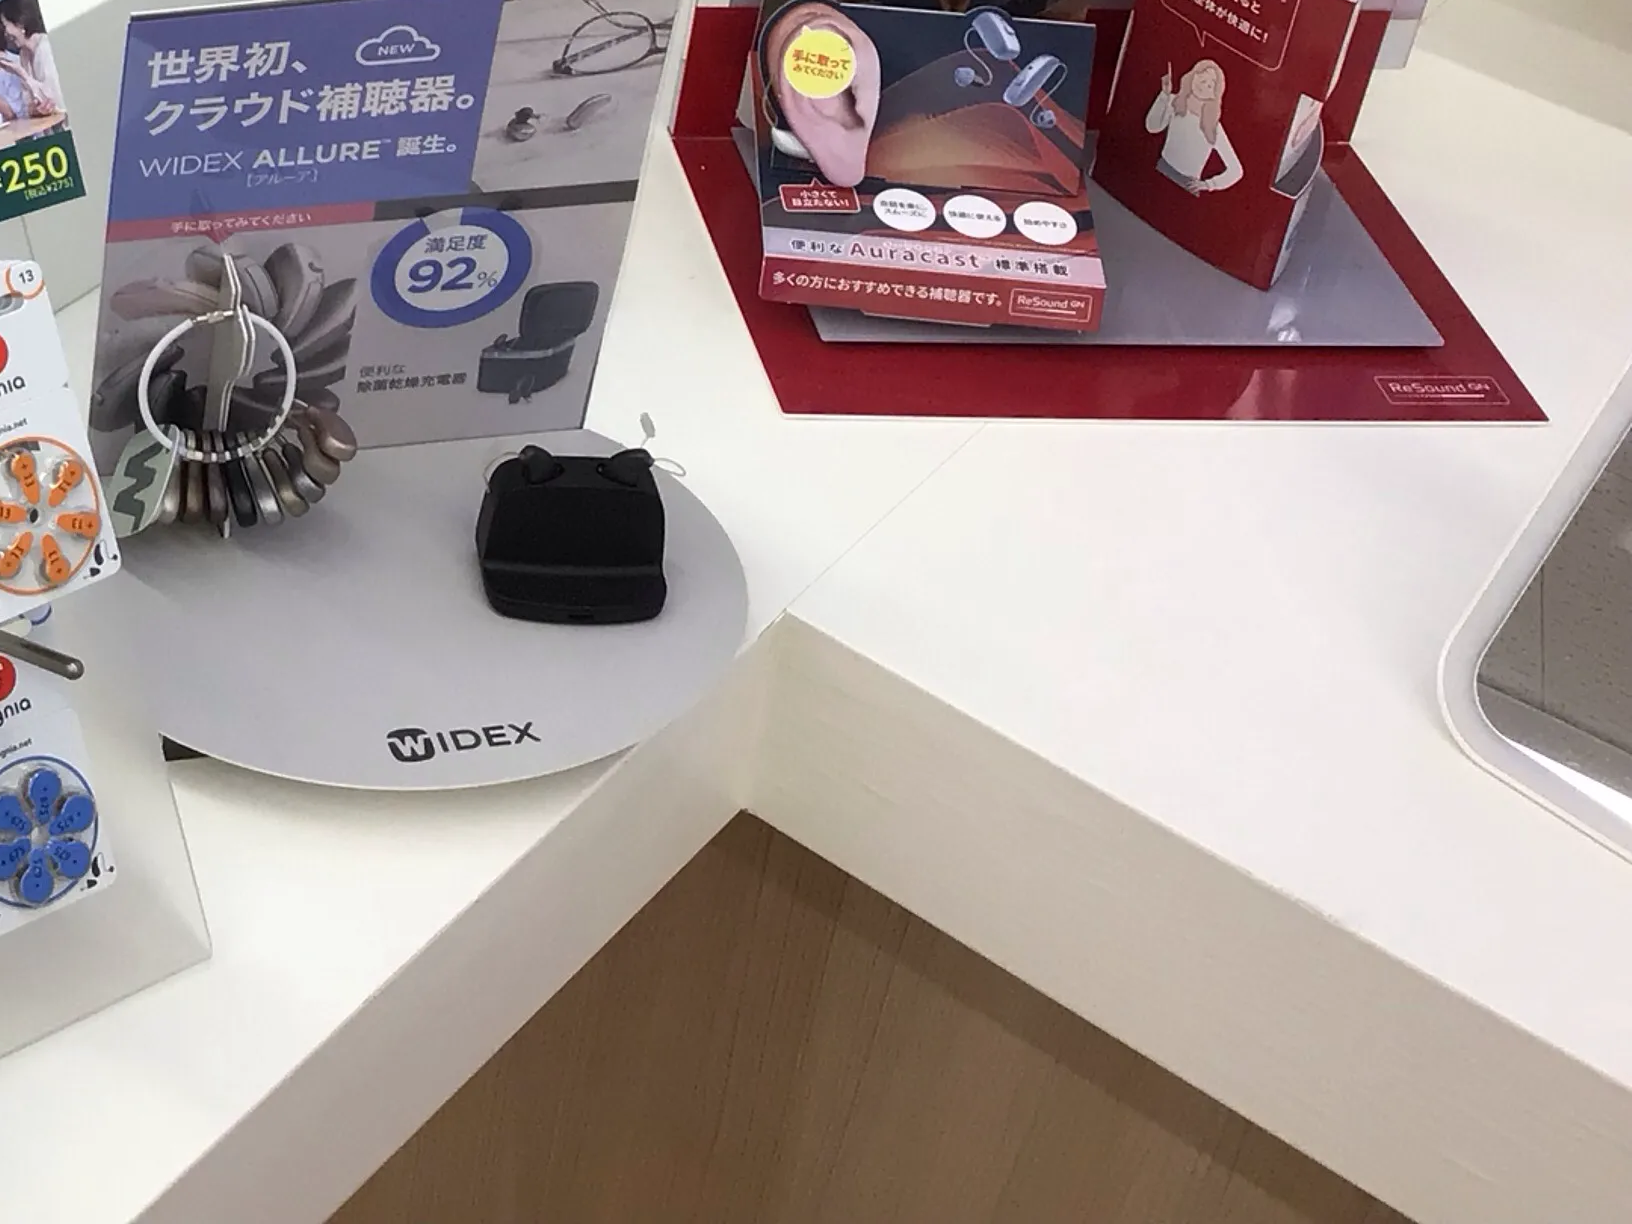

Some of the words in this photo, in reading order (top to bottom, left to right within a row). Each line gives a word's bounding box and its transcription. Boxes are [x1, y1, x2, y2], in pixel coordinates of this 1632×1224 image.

[377, 43, 416, 57] NEW
[792, 49, 852, 71] 手に取って
[148, 40, 309, 89] 世界初、
[144, 74, 475, 137] クラウド補聴器。
[138, 150, 245, 179] WIDEX
[395, 134, 458, 159] 誕生。
[170, 211, 312, 234] 手に取ってみてください
[424, 233, 489, 254] 満足度
[19, 269, 35, 284] 13
[407, 256, 499, 294] 92%
[994, 256, 1070, 278] 標準搭載
[772, 270, 1004, 309] 多くの方におすすめできる補聴器です。
[1017, 295, 1069, 311] ReSound
[356, 372, 468, 394] 除菌乾燥充電器
[1387, 381, 1467, 394] ReSound
[386, 718, 542, 763] WIDEX
